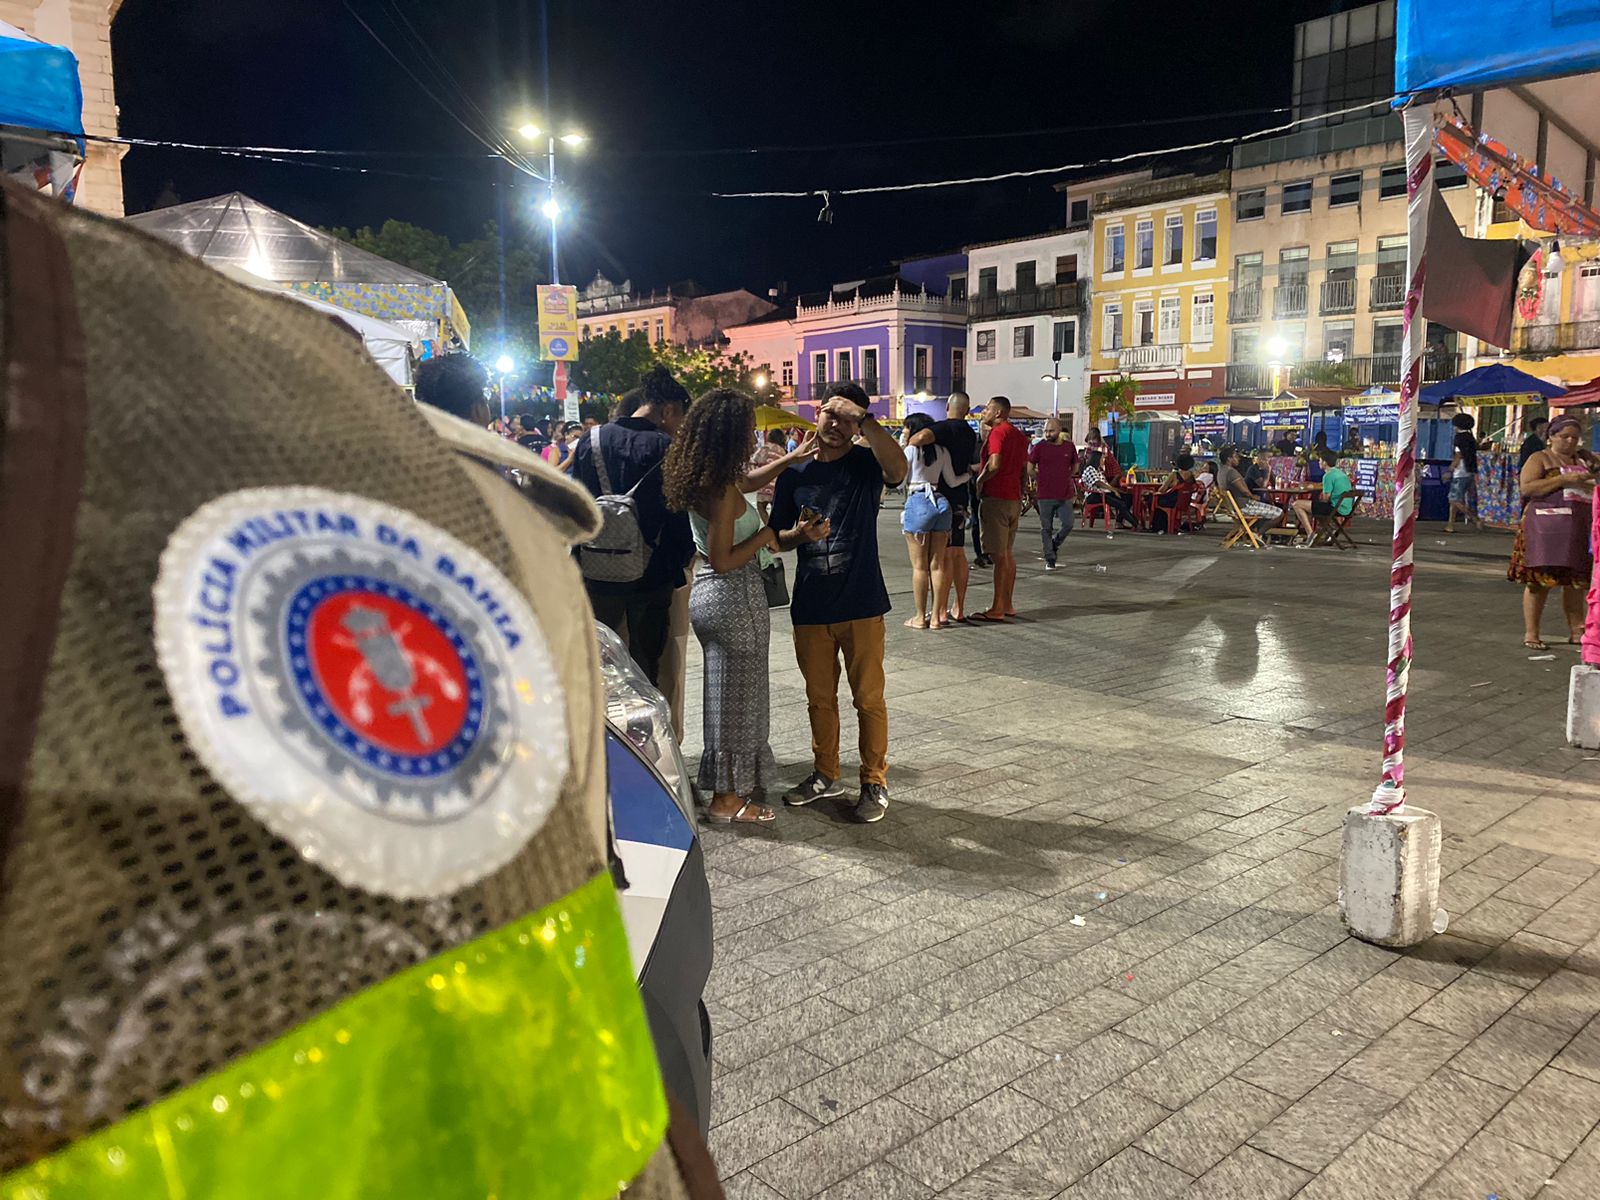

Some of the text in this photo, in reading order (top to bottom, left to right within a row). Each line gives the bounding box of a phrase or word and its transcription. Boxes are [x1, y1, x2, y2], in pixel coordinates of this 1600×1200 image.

[190, 510, 523, 718] POLÍCIA MILITAR DA BAHIA
